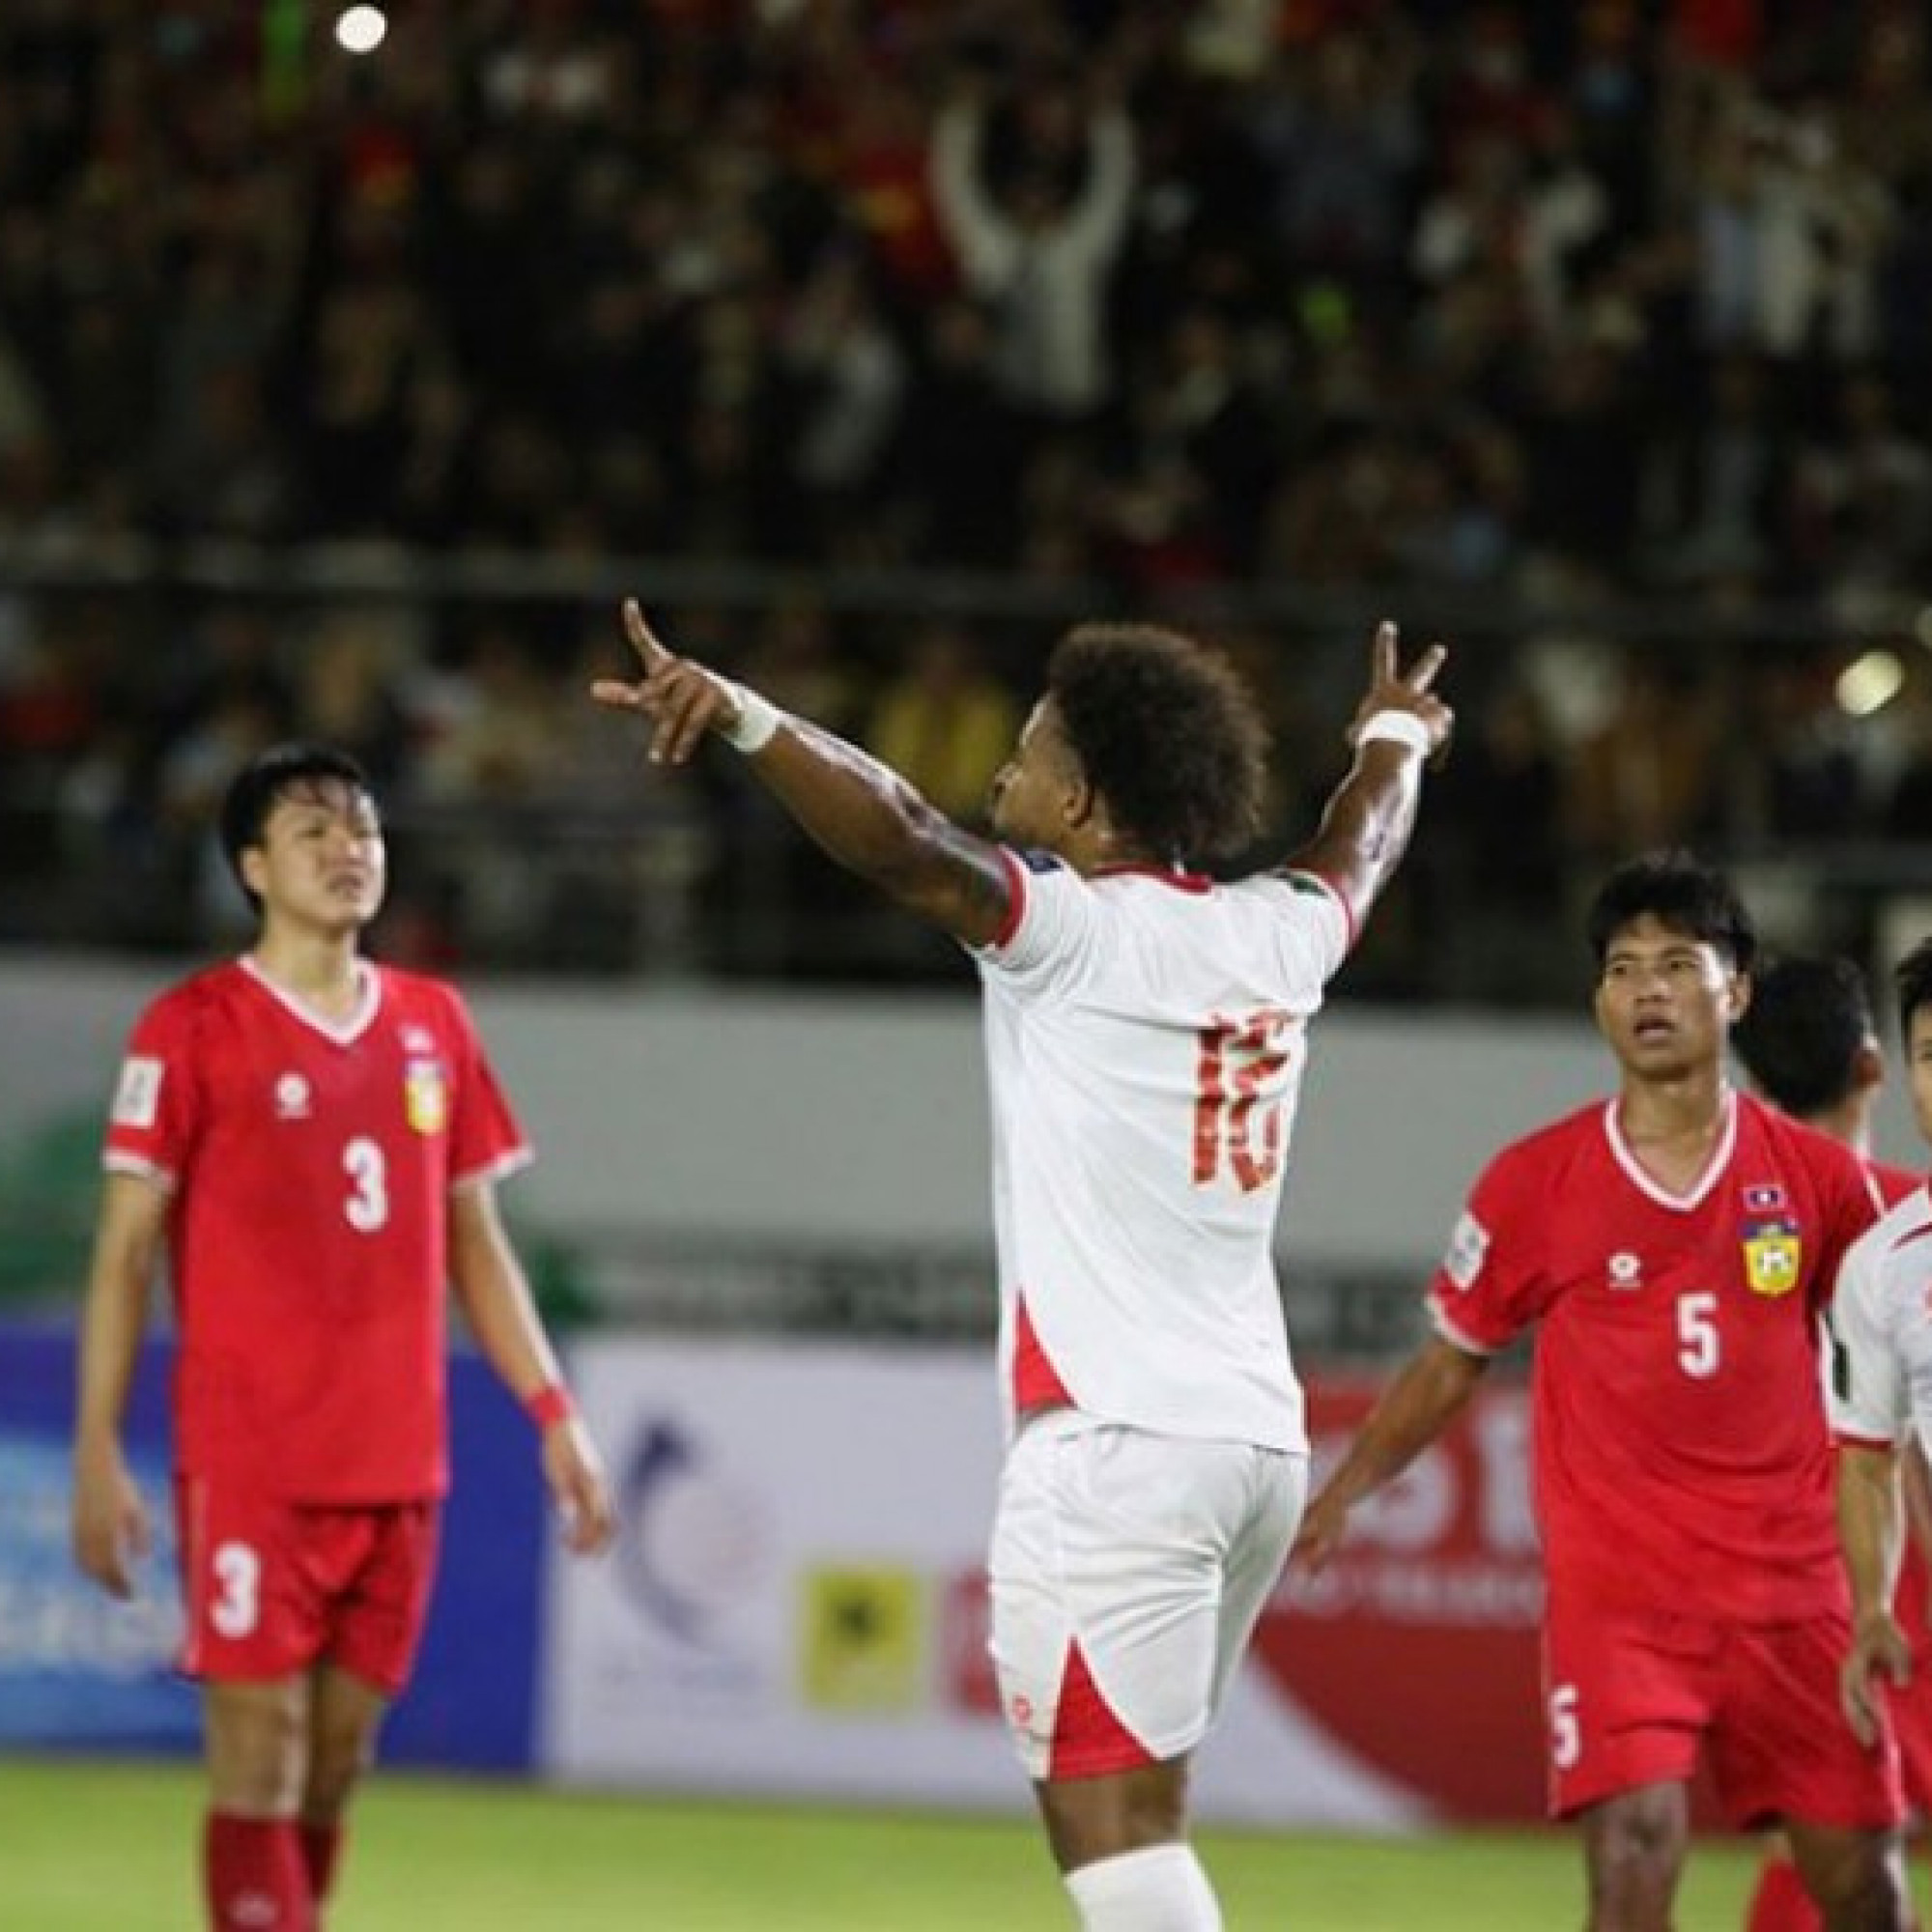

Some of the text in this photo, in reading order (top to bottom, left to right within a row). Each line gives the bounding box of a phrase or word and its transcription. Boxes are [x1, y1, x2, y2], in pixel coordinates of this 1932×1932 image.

[341, 1136, 388, 1232] 3
[1676, 1291, 1720, 1378] 5
[209, 1540, 261, 1638] 3
[1548, 1684, 1579, 1769] 5
